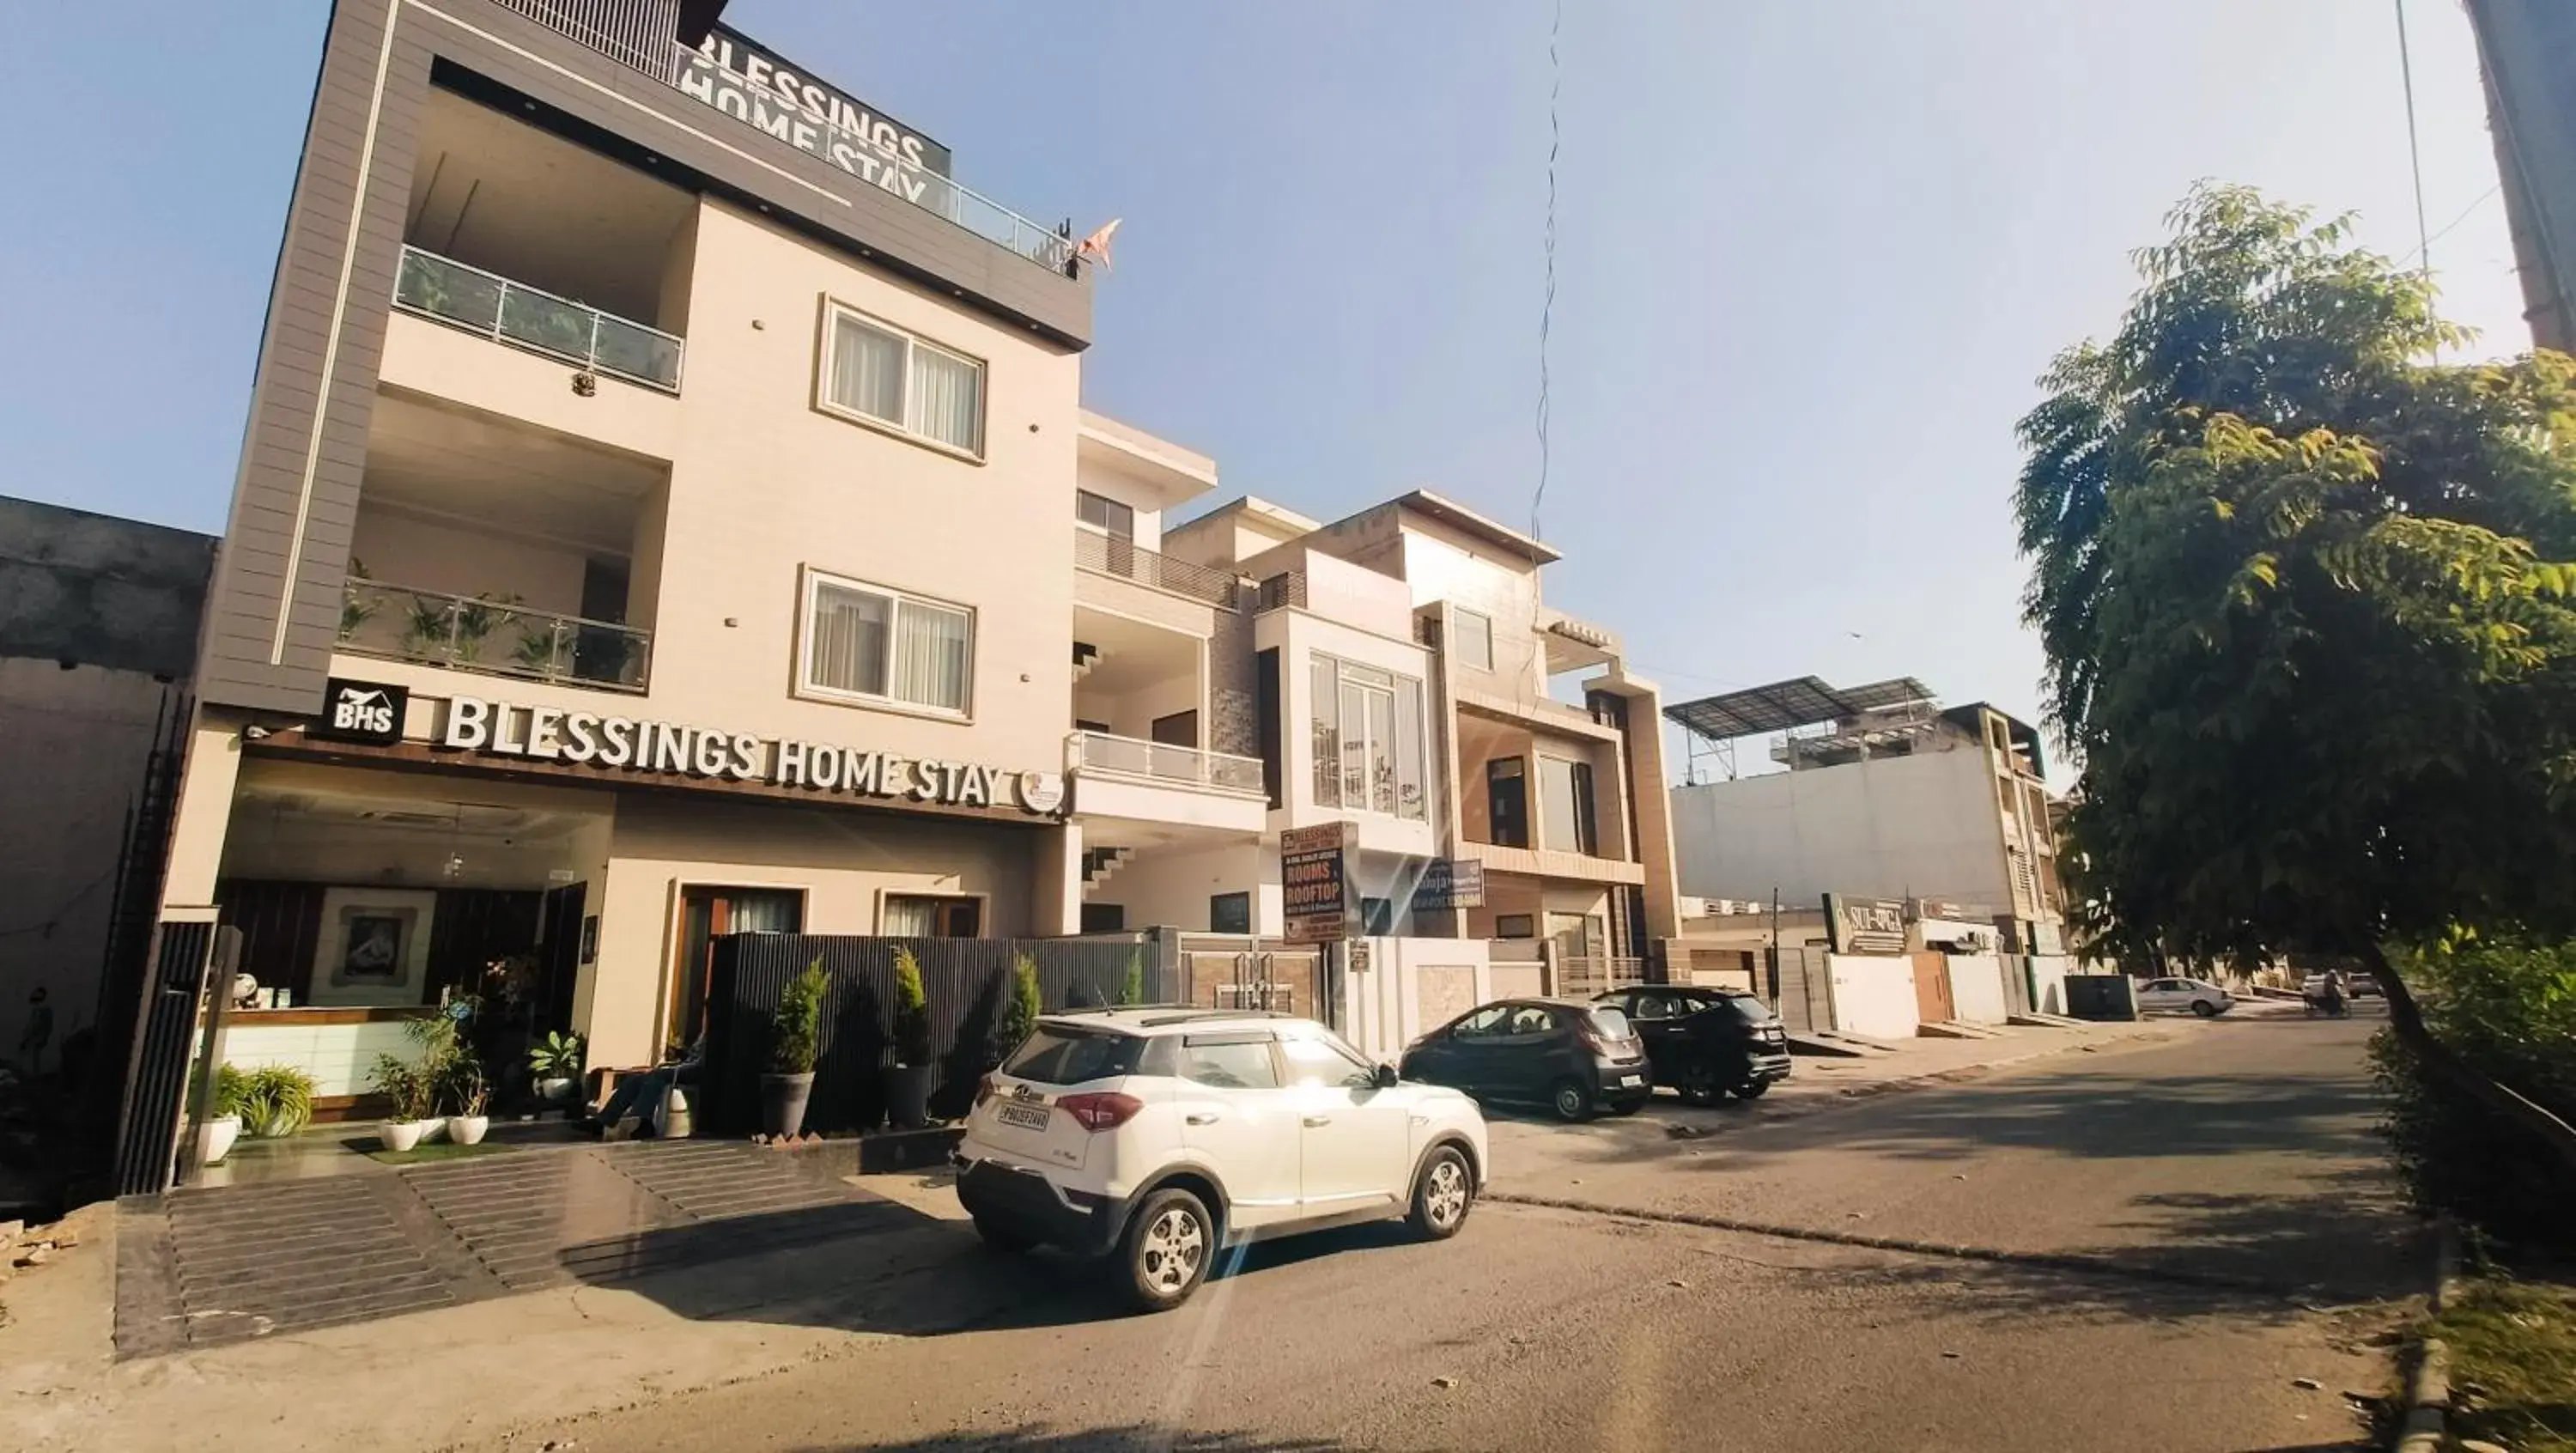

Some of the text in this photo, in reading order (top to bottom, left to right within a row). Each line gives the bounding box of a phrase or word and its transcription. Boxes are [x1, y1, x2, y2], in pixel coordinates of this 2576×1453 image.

[681, 69, 927, 203] HOME STAY
[334, 702, 393, 733] BHS
[445, 694, 1003, 805] BLESSINGS HOME STAY
[1287, 860, 1331, 883] ROOMS
[1285, 881, 1340, 904] ROOFTOP
